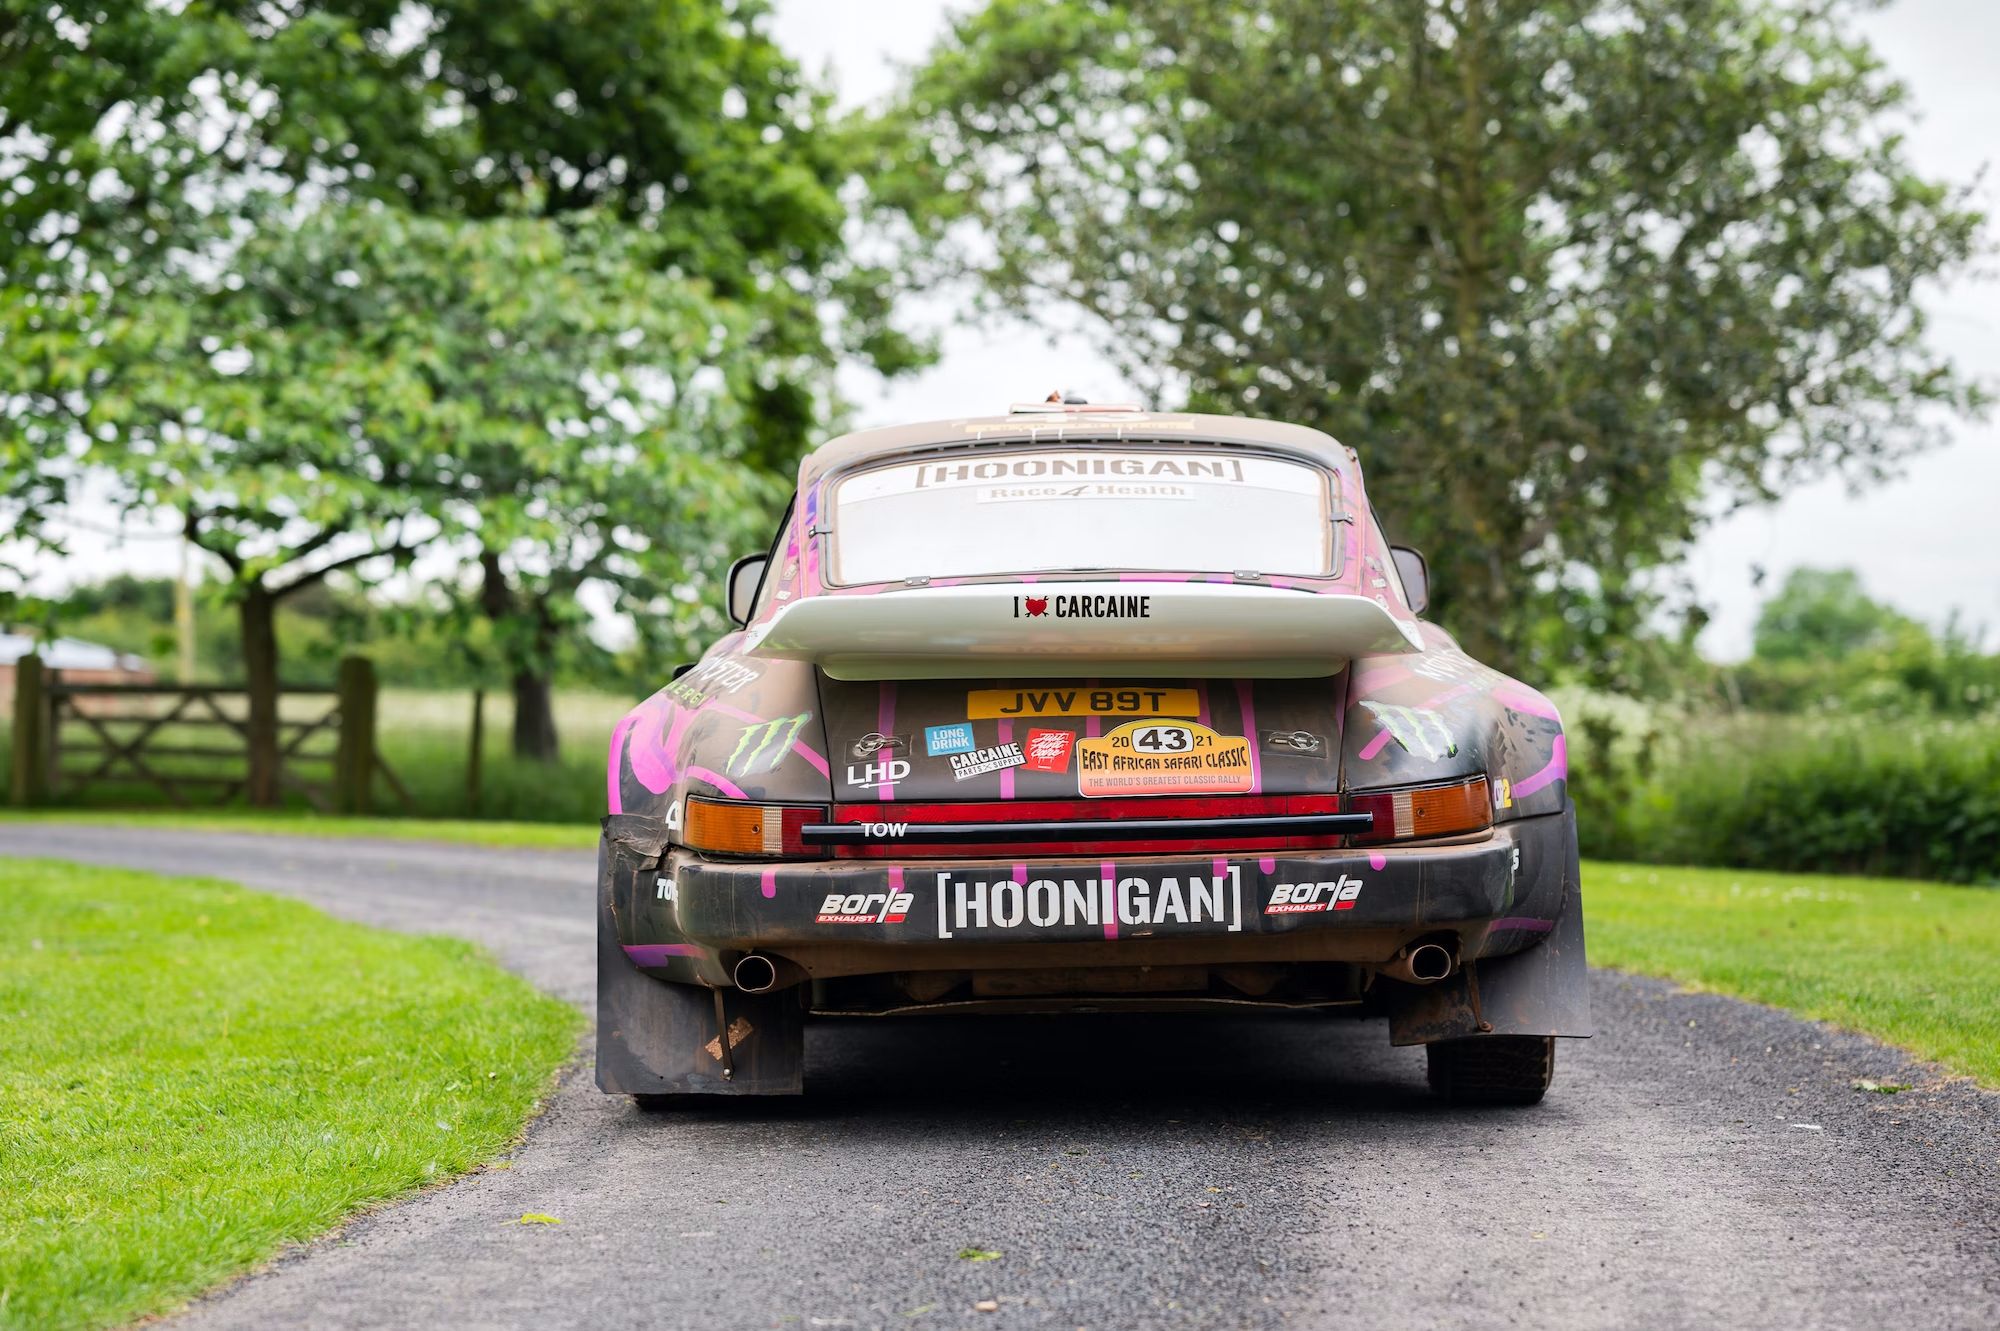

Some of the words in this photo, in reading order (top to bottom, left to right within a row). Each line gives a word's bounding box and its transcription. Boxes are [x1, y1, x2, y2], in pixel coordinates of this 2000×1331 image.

[990, 484, 1056, 499] Race
[1096, 484, 1186, 497] Health
[1013, 597, 1020, 618] I
[1055, 596, 1150, 618] CARCAINE
[1000, 692, 1077, 713] JVV
[1090, 691, 1167, 712] 89T
[931, 737, 970, 750] DRINK
[933, 728, 965, 740] LONG
[1112, 736, 1130, 748] 20
[1138, 729, 1187, 751] 43
[1195, 735, 1213, 747] 21
[949, 742, 1022, 769] CARCAINE
[1082, 748, 1109, 771] EAST
[1113, 754, 1160, 771] AFRICAN
[1164, 754, 1203, 770] SAFARI
[1206, 746, 1248, 769] CLASSIC
[847, 760, 911, 785] LHD
[958, 766, 983, 778] PARTS
[993, 756, 1022, 769] SUPPLY
[1089, 777, 1105, 787] THE
[1105, 776, 1141, 787] WORLD'S
[1142, 776, 1182, 786] GREATEST
[1184, 775, 1216, 785] CLASSIC
[1217, 775, 1241, 785] RALLY
[861, 823, 908, 837] TOW
[1267, 904, 1326, 913] EXHAUST
